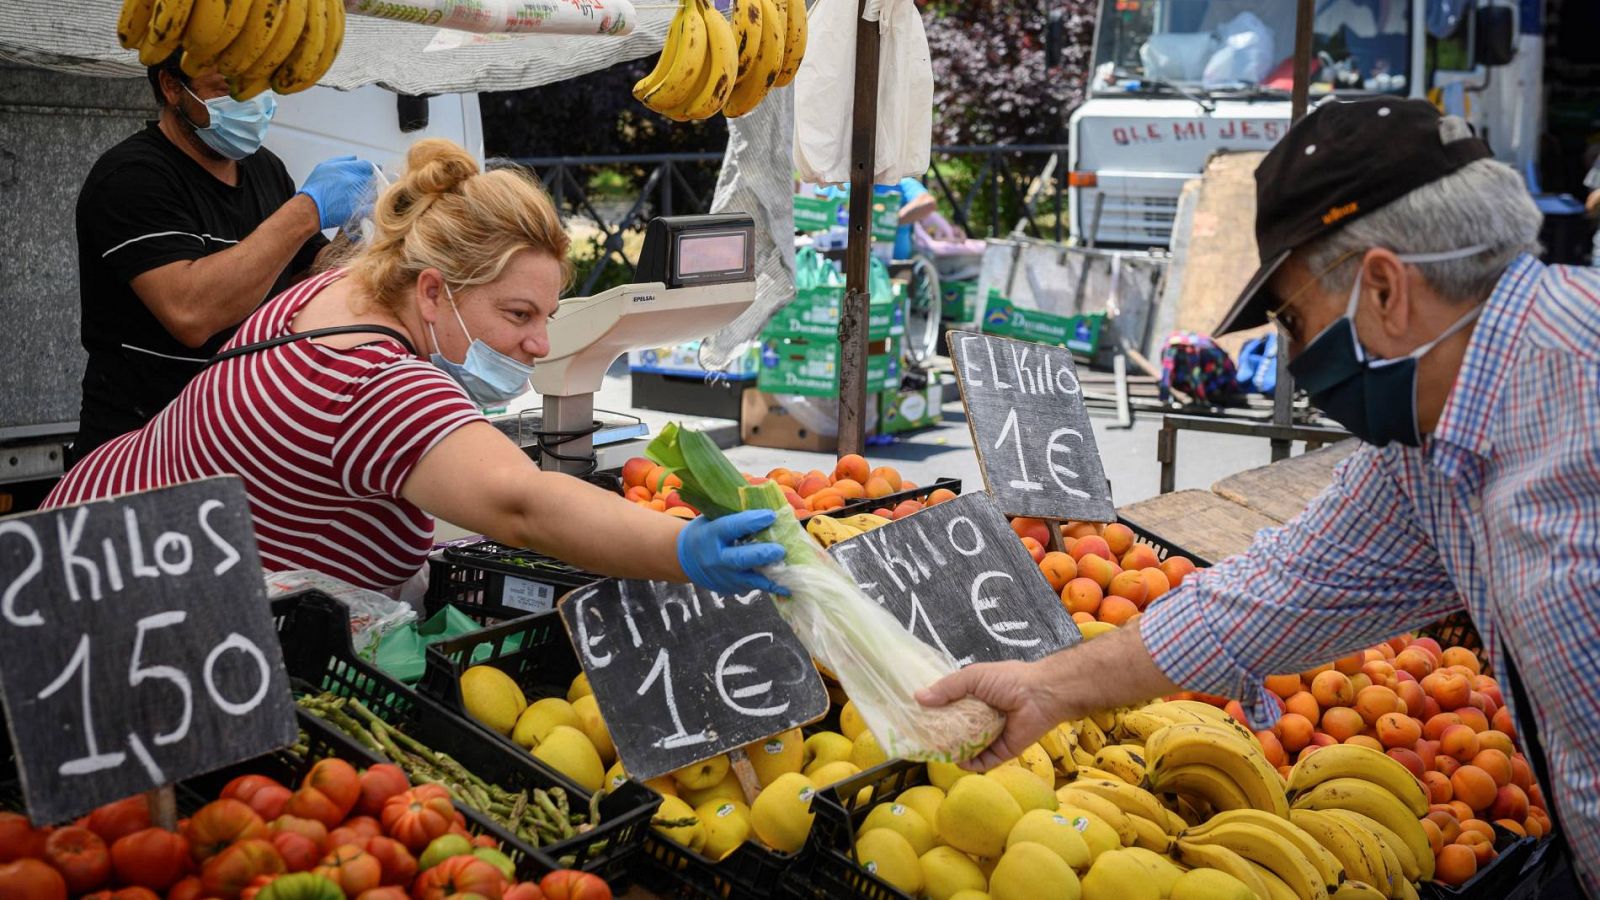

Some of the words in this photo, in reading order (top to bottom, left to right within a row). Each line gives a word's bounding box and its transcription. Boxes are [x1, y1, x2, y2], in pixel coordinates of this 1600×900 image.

[1172, 119, 1207, 141] MI
[1219, 119, 1289, 141] JES
[38, 610, 271, 785] 1,50
